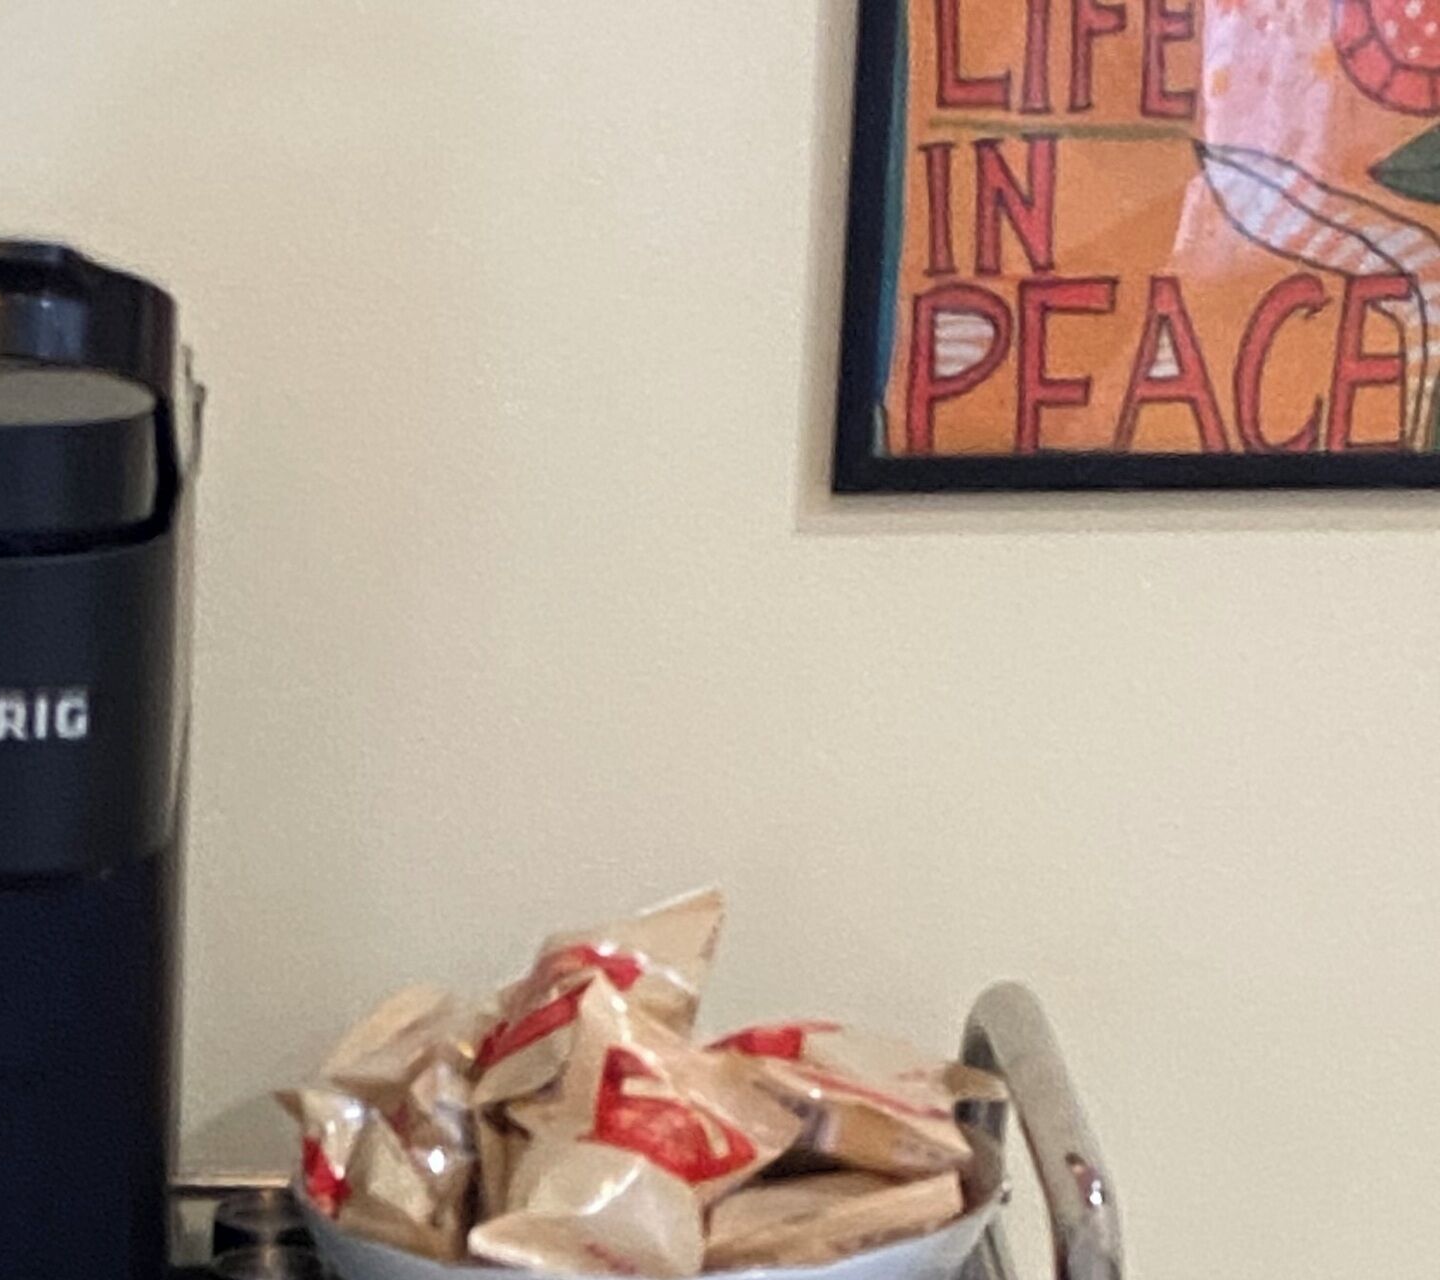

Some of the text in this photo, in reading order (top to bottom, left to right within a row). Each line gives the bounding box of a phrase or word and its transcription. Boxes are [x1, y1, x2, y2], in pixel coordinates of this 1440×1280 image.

[933, 0, 1197, 119] LIFE
[918, 132, 1058, 277] IN
[904, 272, 1422, 455] PEACE
